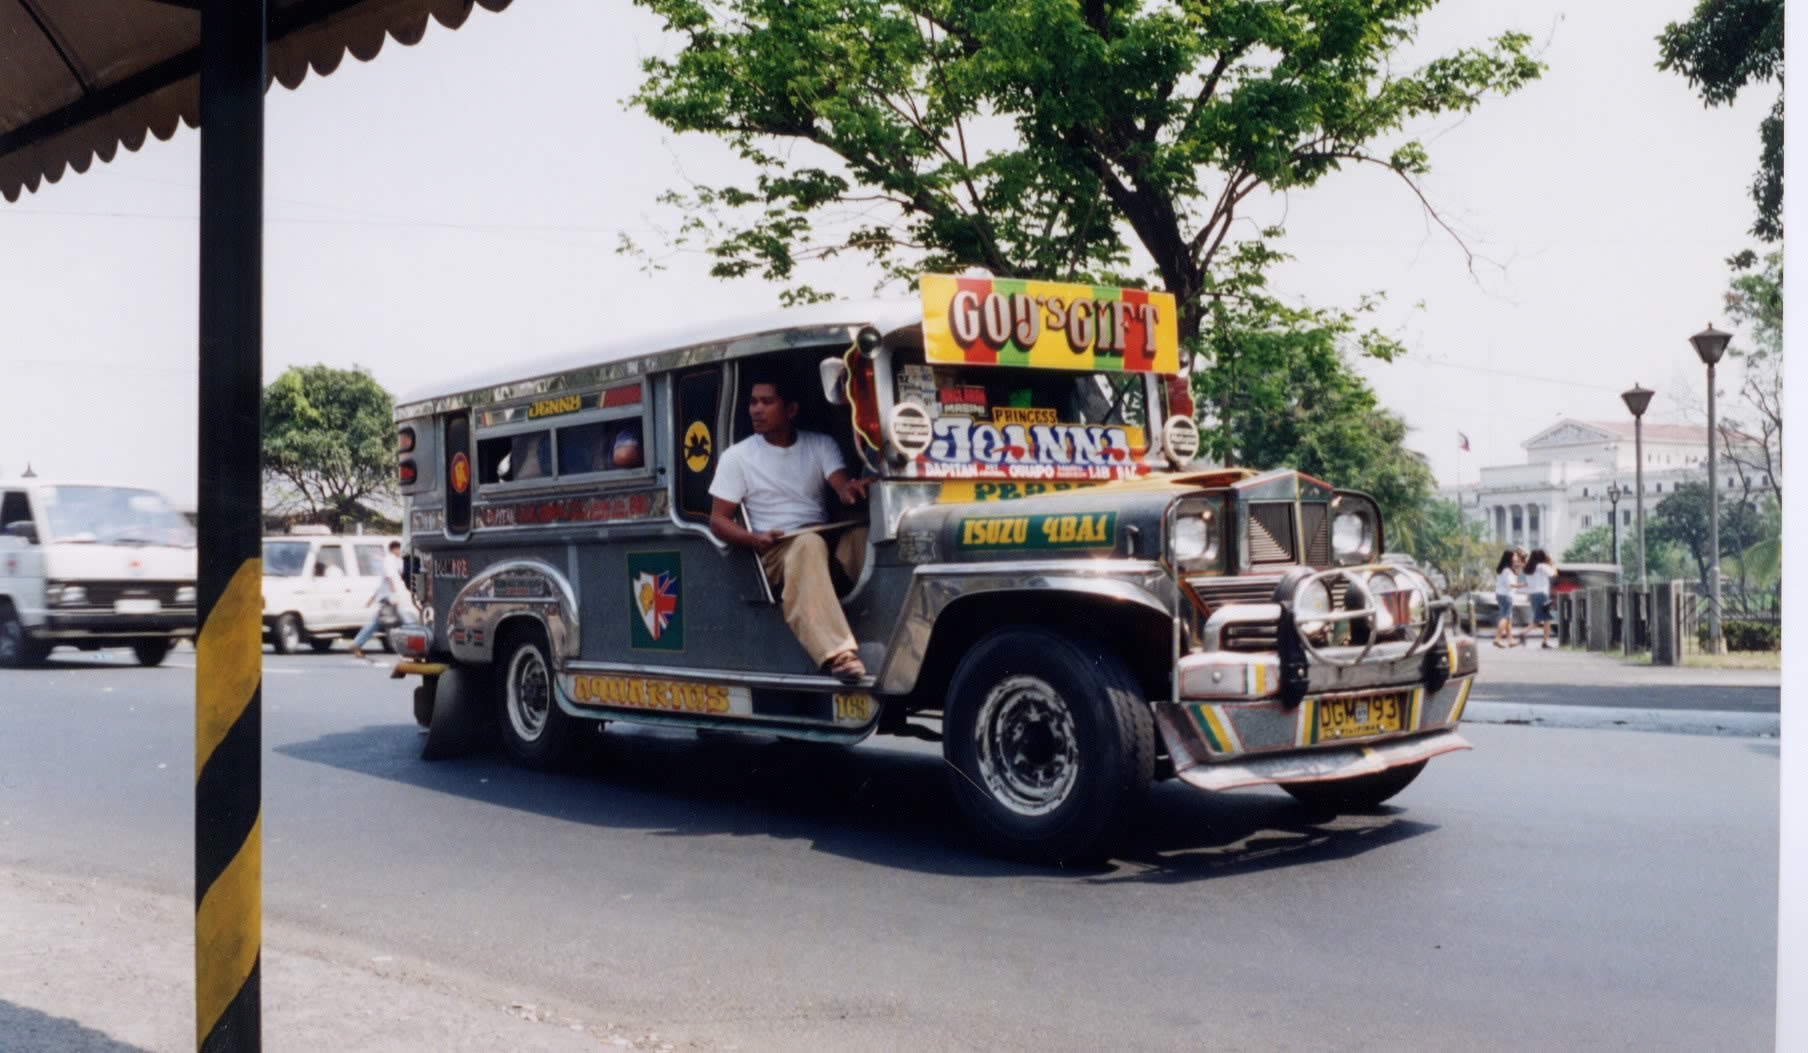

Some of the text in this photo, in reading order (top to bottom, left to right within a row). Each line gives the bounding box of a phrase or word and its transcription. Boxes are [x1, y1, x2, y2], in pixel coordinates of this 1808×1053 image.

[951, 289, 1160, 360] GOD'S GIFT
[528, 394, 582, 418] JENNY
[994, 408, 1057, 424] PRINCESS
[930, 415, 1131, 466] JOANNA
[1008, 463, 1055, 479] QUIAPO
[962, 517, 1029, 545] ISUZU
[574, 675, 730, 713] AQUARIUS
[1360, 692, 1397, 721] 793
